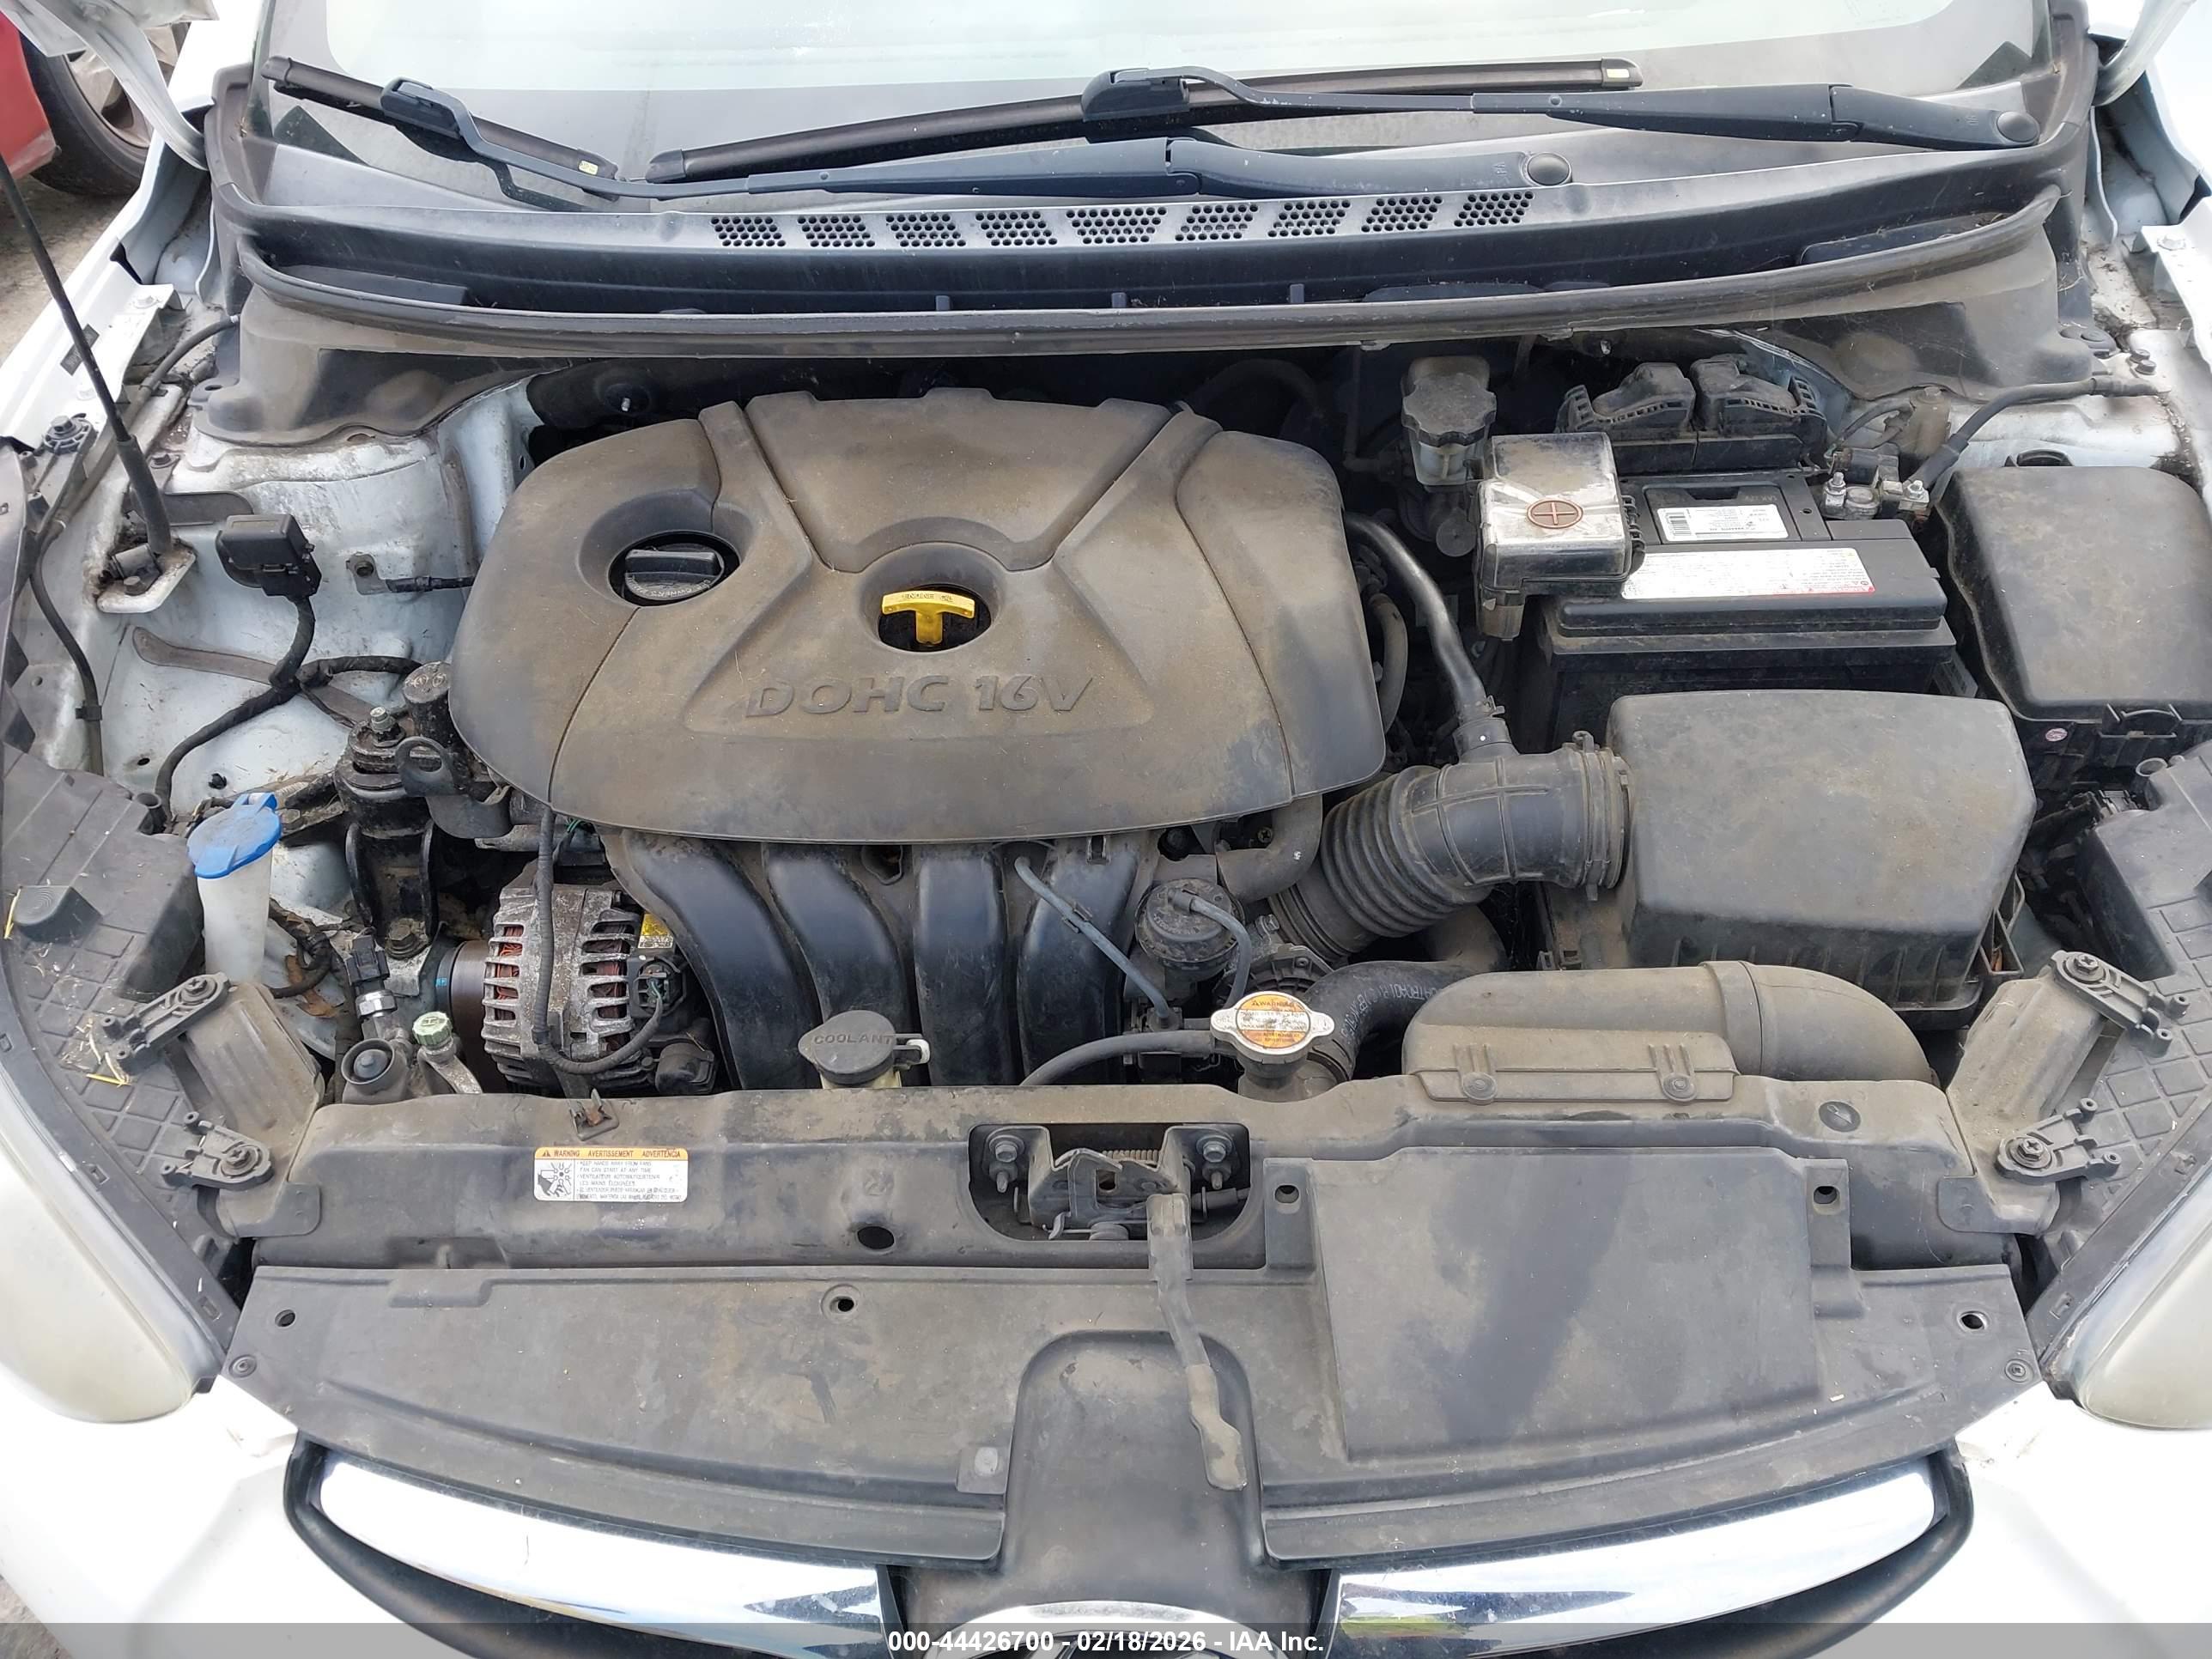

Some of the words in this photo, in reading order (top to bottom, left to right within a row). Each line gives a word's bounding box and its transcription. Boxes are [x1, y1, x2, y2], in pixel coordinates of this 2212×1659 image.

[745, 675, 948, 717] DOHC
[972, 675, 1093, 712] 16V
[814, 1033, 895, 1045] COOLANT
